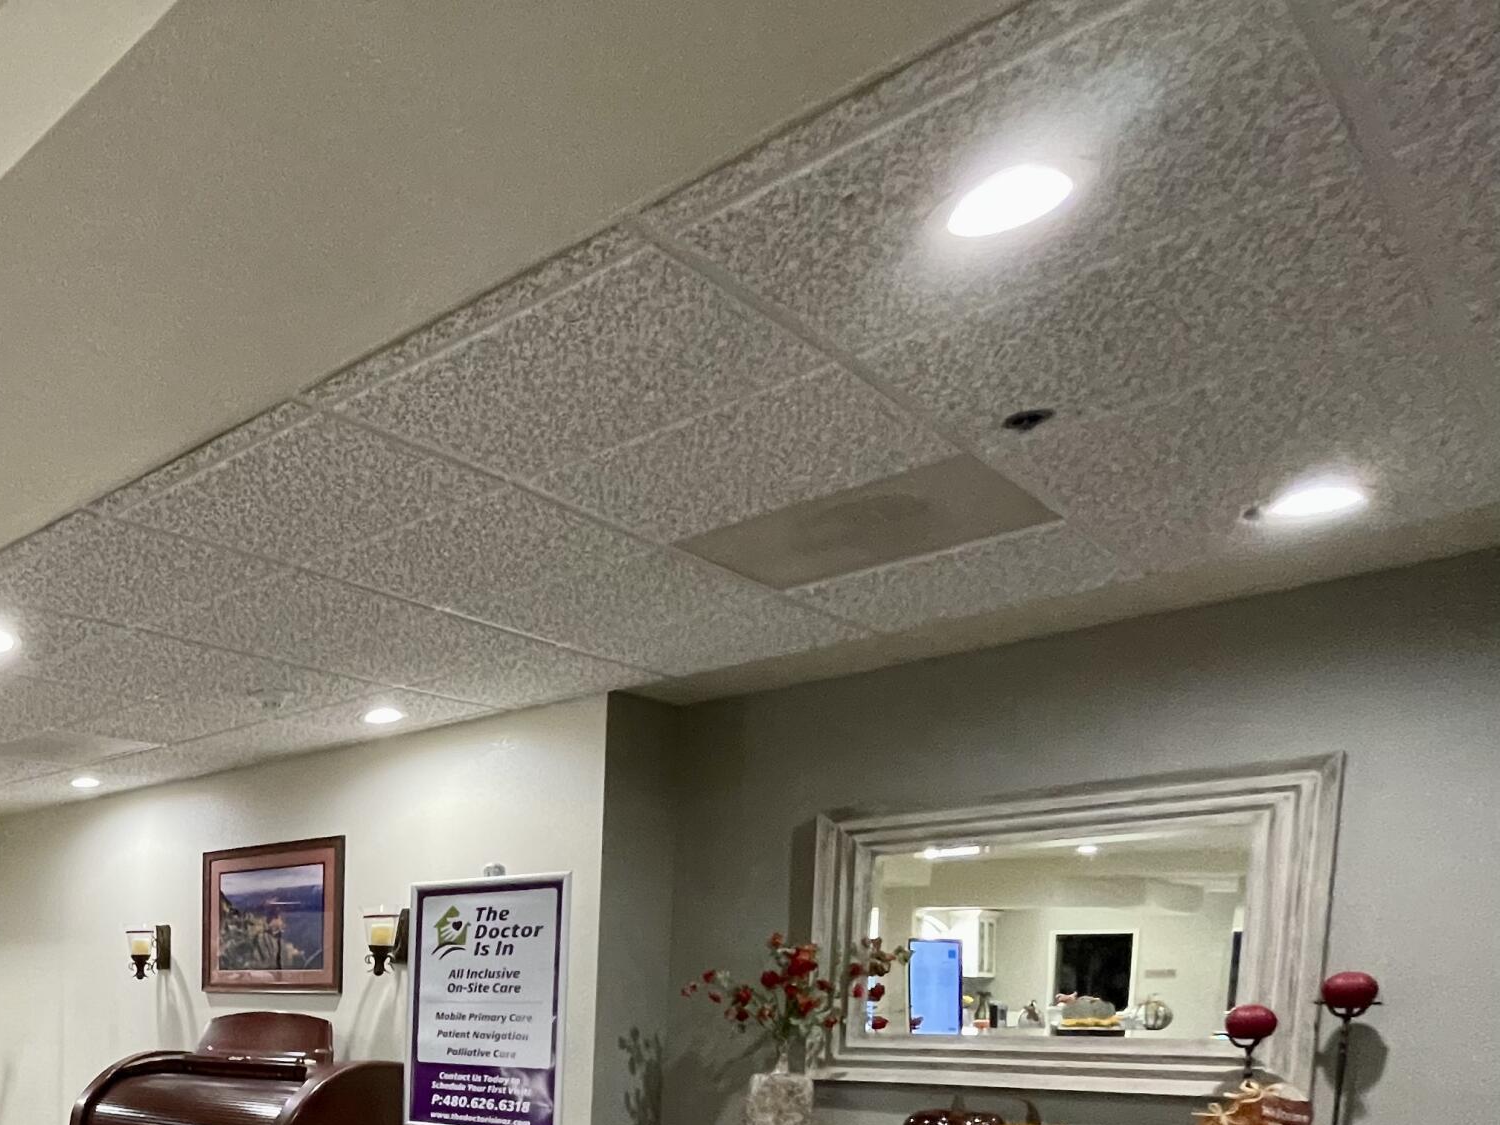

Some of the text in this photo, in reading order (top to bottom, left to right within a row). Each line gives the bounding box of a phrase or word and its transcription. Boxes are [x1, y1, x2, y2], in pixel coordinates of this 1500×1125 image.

[476, 906, 510, 922] The
[474, 924, 544, 939] Doctor
[473, 940, 514, 956] Is In
[448, 967, 521, 979] All Inclusive
[447, 982, 522, 993] On-Site Care
[435, 1011, 533, 1024] Mobile Primary Care
[437, 1029, 529, 1042] Patient Navigation
[446, 1047, 516, 1059] Palliative Care
[439, 1071, 471, 1082] Contact
[472, 1073, 482, 1082] Us
[483, 1074, 509, 1085] Today
[431, 1080, 466, 1091] Schedule
[468, 1083, 487, 1092] Your
[487, 1084, 506, 1095] First
[431, 1093, 531, 1114] P:480.626.6318
